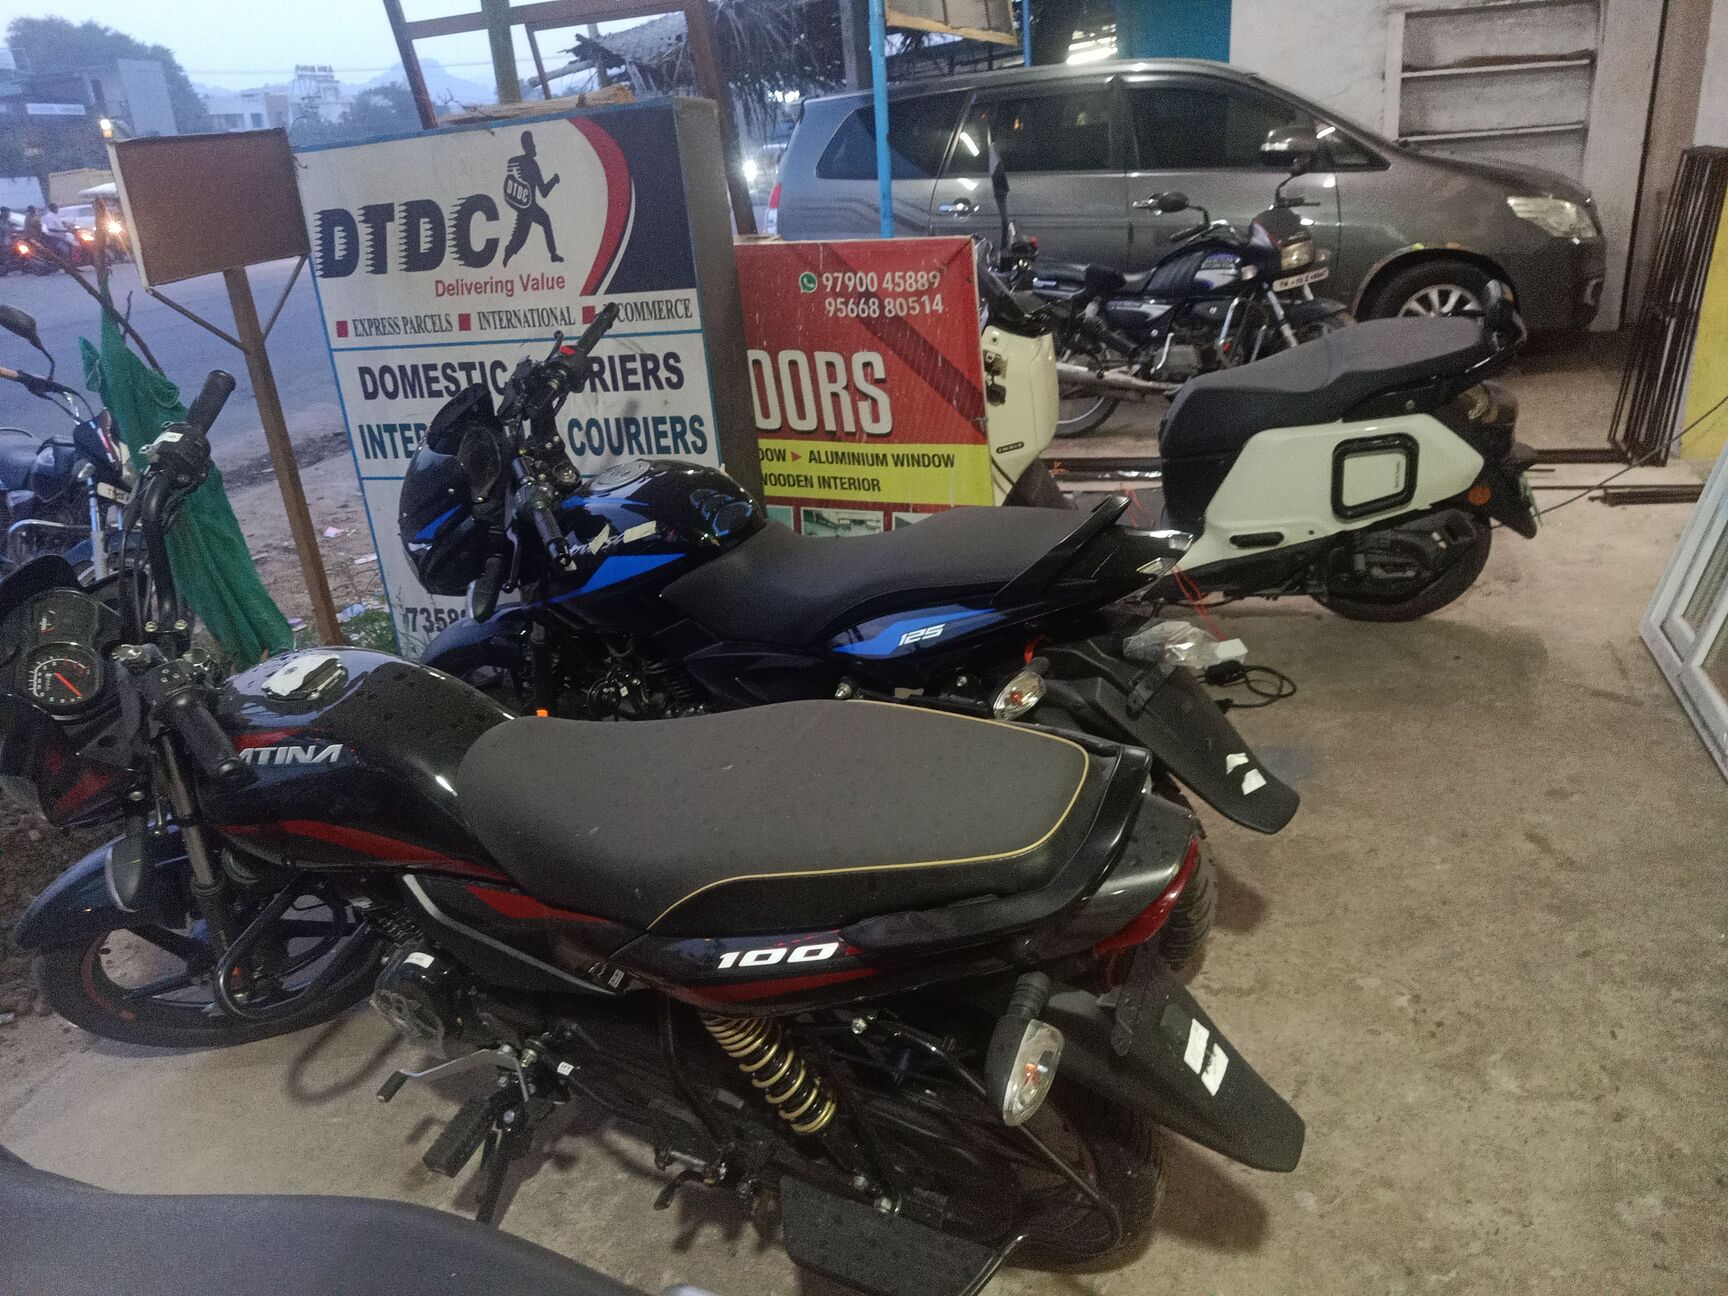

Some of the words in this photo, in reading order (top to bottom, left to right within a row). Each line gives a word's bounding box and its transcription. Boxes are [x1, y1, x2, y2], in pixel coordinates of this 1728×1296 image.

[507, 179, 529, 203] DTDC
[314, 194, 499, 278] DTDC
[434, 275, 514, 298] Delivering
[520, 272, 566, 291] Value
[822, 271, 878, 292] 97900
[882, 271, 941, 292] 45889
[352, 315, 401, 337] EXPRESS
[402, 313, 454, 335] PARCELS
[477, 306, 576, 331] INTERNATIONAL
[603, 298, 693, 323] COMMERCE
[825, 297, 880, 317] 95668
[884, 293, 944, 317] 80514
[357, 359, 508, 401] DOMESTIC
[567, 415, 708, 456] COURIERS
[808, 450, 889, 467] ALUMINIUM
[890, 453, 956, 468] WINDOW
[817, 475, 881, 492] INTERIOR
[898, 623, 945, 647] 125
[717, 942, 839, 970] 100
